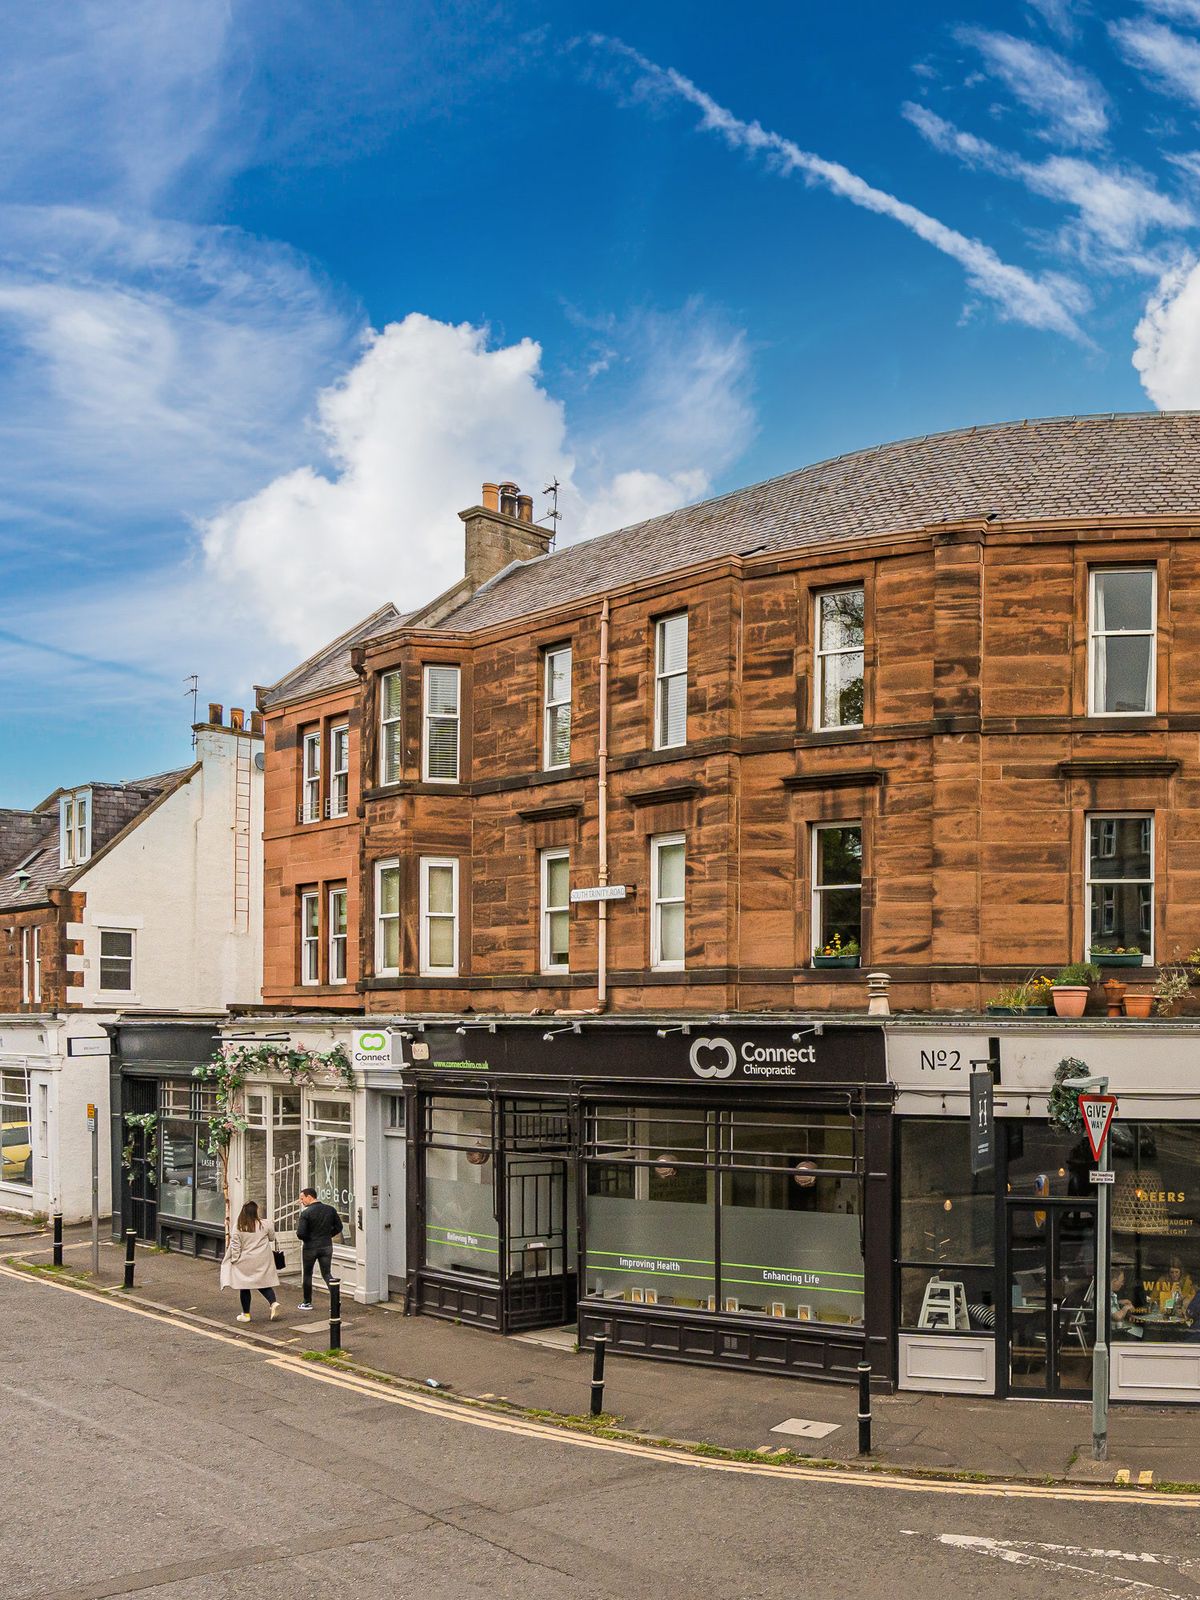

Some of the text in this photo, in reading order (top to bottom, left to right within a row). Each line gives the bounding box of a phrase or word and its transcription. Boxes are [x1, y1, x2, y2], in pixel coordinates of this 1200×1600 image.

[355, 1052, 390, 1061] Connect
[741, 1041, 816, 1063] Connect
[743, 1063, 796, 1077] Chiropractic
[1086, 1105, 1107, 1118] GIVE
[1091, 1120, 1104, 1129] WAY
[333, 1189, 339, 1203] &
[342, 1189, 353, 1204] Co
[619, 1257, 681, 1271] Improving Health
[762, 1270, 820, 1285] Enhancing Life
[1143, 1281, 1180, 1291] WINE
